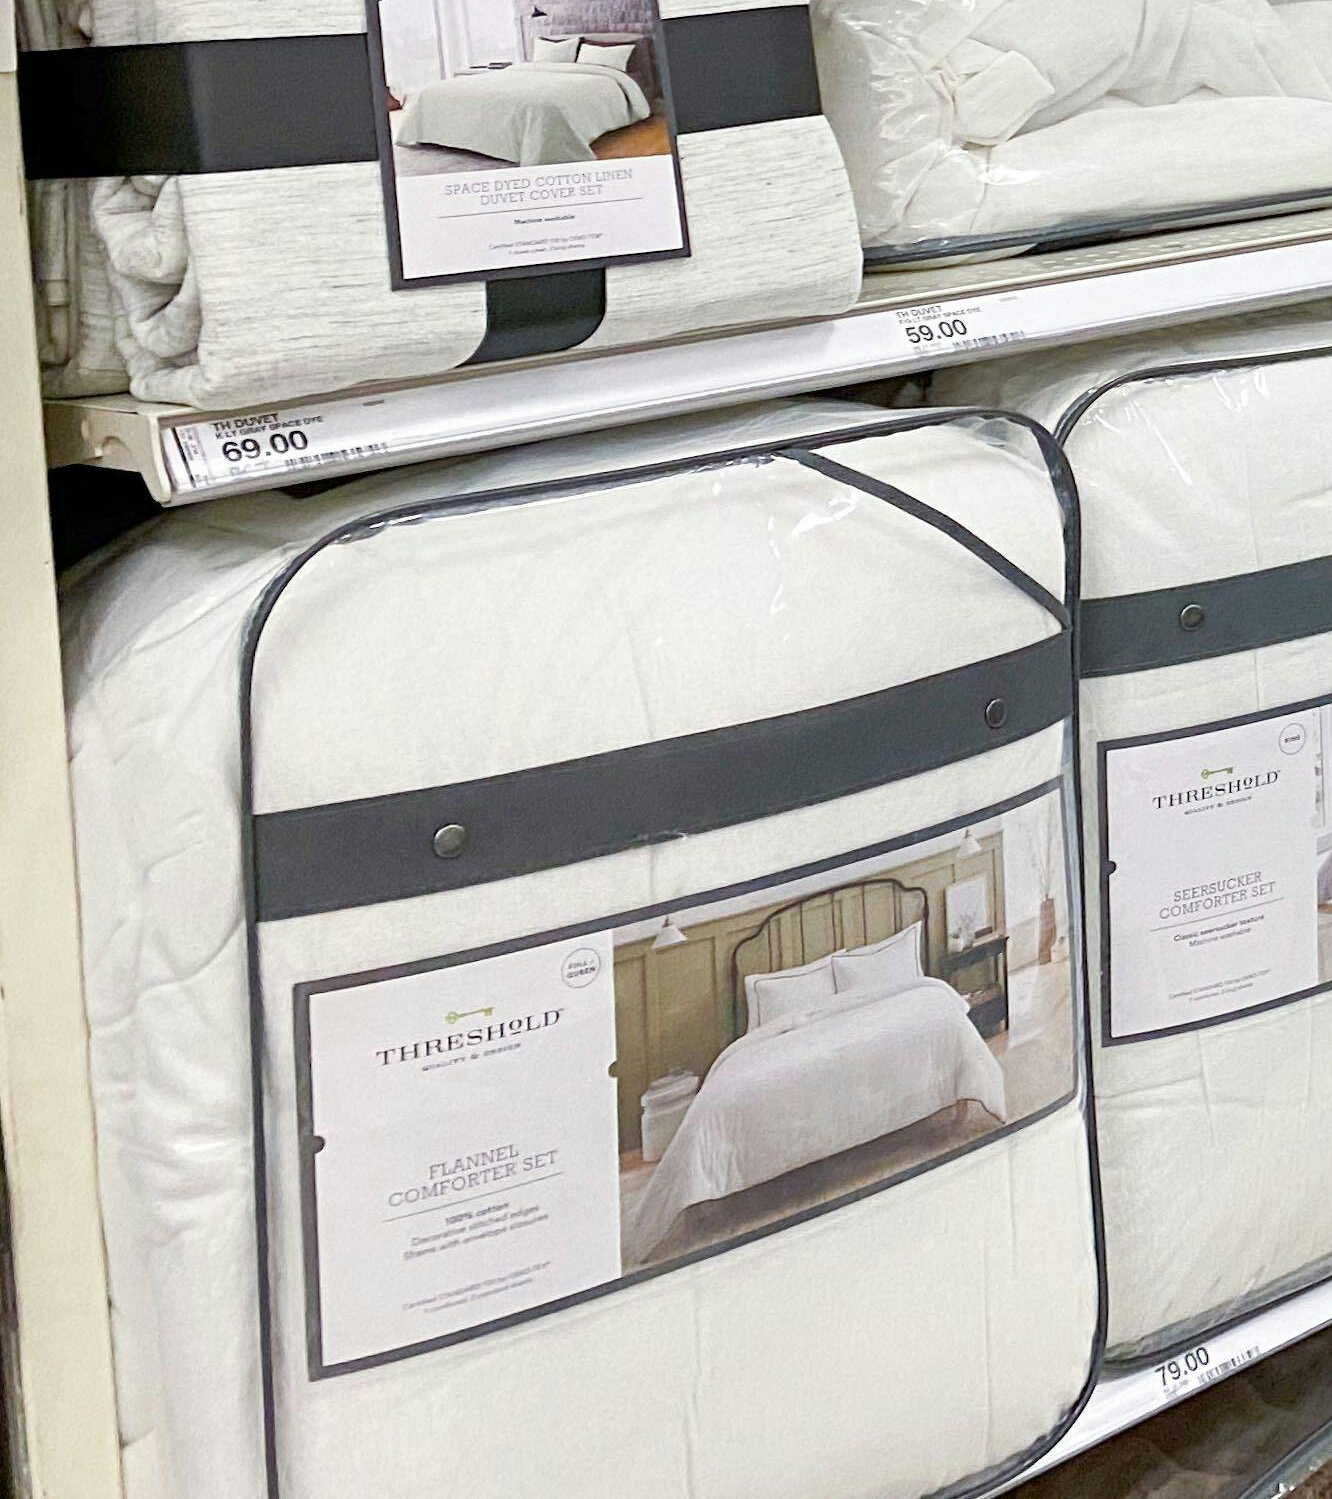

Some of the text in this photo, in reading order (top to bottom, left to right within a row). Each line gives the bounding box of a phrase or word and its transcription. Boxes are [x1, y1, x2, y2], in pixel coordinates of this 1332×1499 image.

[444, 168, 633, 197] SPACE DYED COTTON LINEN
[480, 184, 603, 206] DUVET COVER SET
[896, 305, 942, 319] TH DUVET
[905, 319, 967, 344] 59.00
[211, 413, 280, 432] TH DUVET
[270, 419, 300, 432] SPACE
[221, 429, 308, 463] 69.00
[1158, 880, 1277, 921] COMFORTER SET
[1173, 870, 1262, 903] SEERSUCKER
[376, 1009, 561, 1066] THRESHOLD
[427, 1143, 520, 1181] FLANNEL
[387, 1149, 558, 1209] COMFORTER SET
[1154, 1346, 1210, 1386] 79.00
